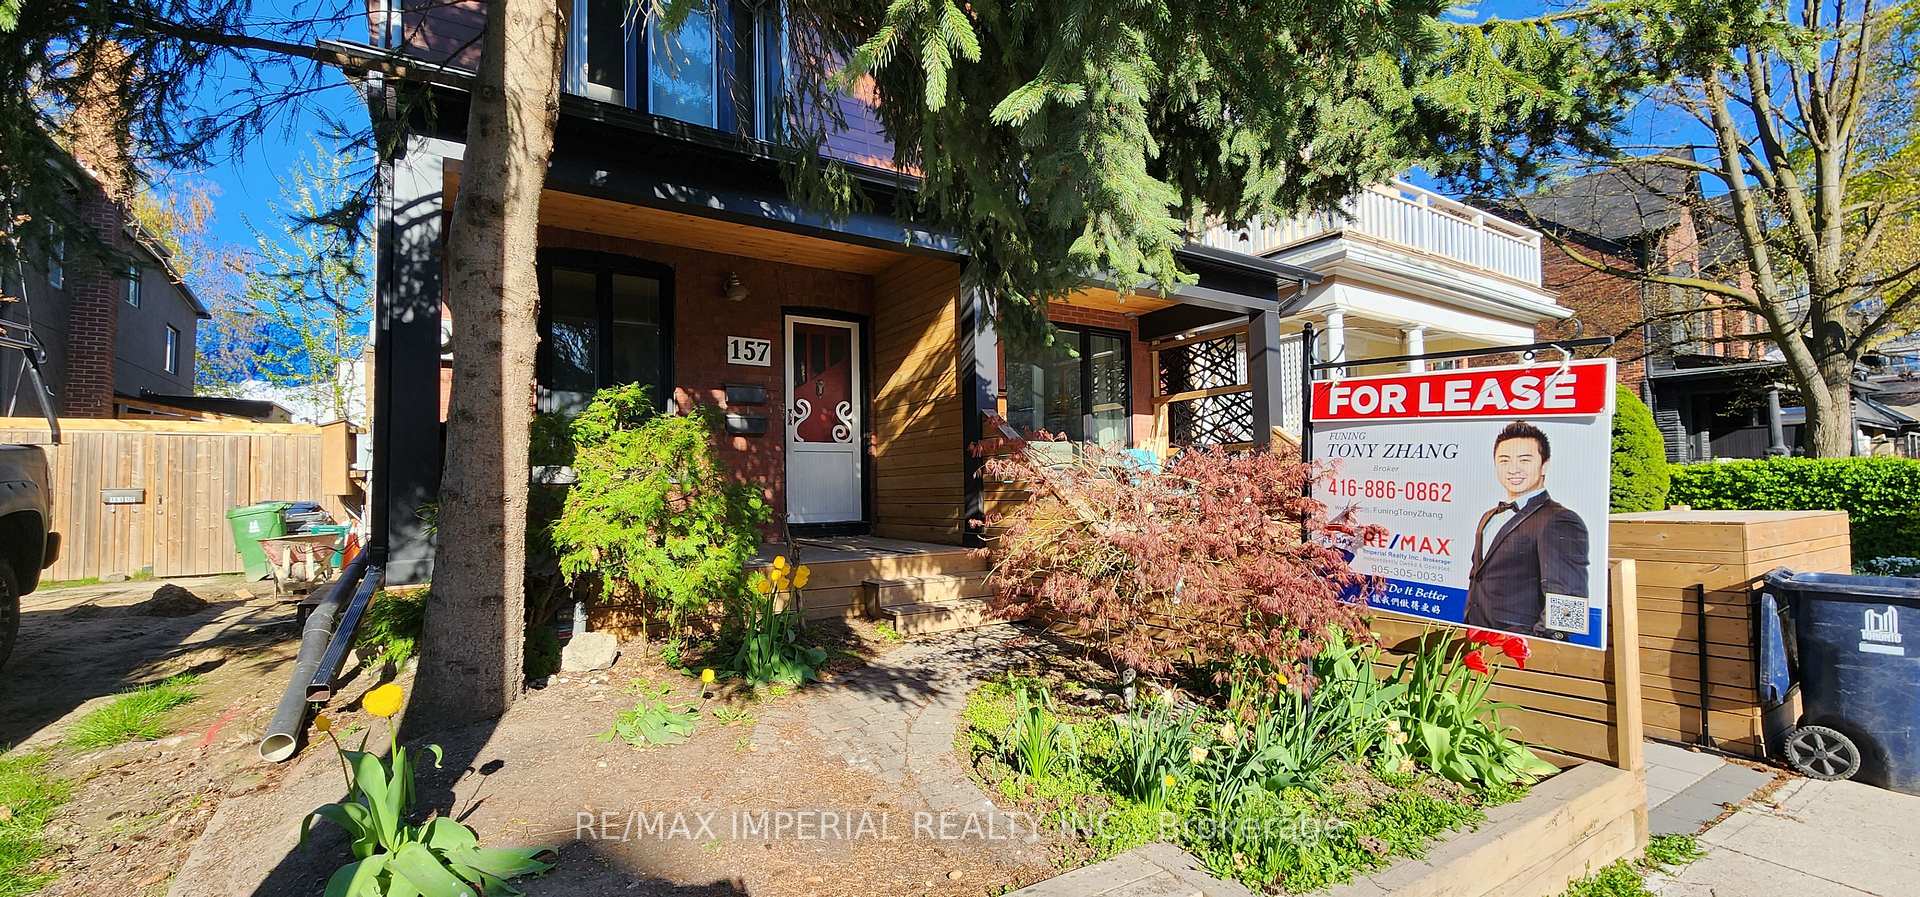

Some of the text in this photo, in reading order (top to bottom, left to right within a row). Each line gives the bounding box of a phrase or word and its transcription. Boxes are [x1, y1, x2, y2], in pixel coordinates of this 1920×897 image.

[730, 339, 770, 362] 157
[1328, 373, 1577, 415] FOR LEASE
[1329, 432, 1367, 441] FUNING
[1327, 443, 1459, 460] TONY ZHANG
[1328, 478, 1453, 503] 416-886-0862
[1373, 506, 1444, 520] FuningTonyZhang
[1363, 531, 1451, 556] RE/MAX
[1387, 551, 1407, 561] Realty
[1371, 564, 1444, 582] 905-305-0033
[1388, 583, 1448, 601] Do It Better
